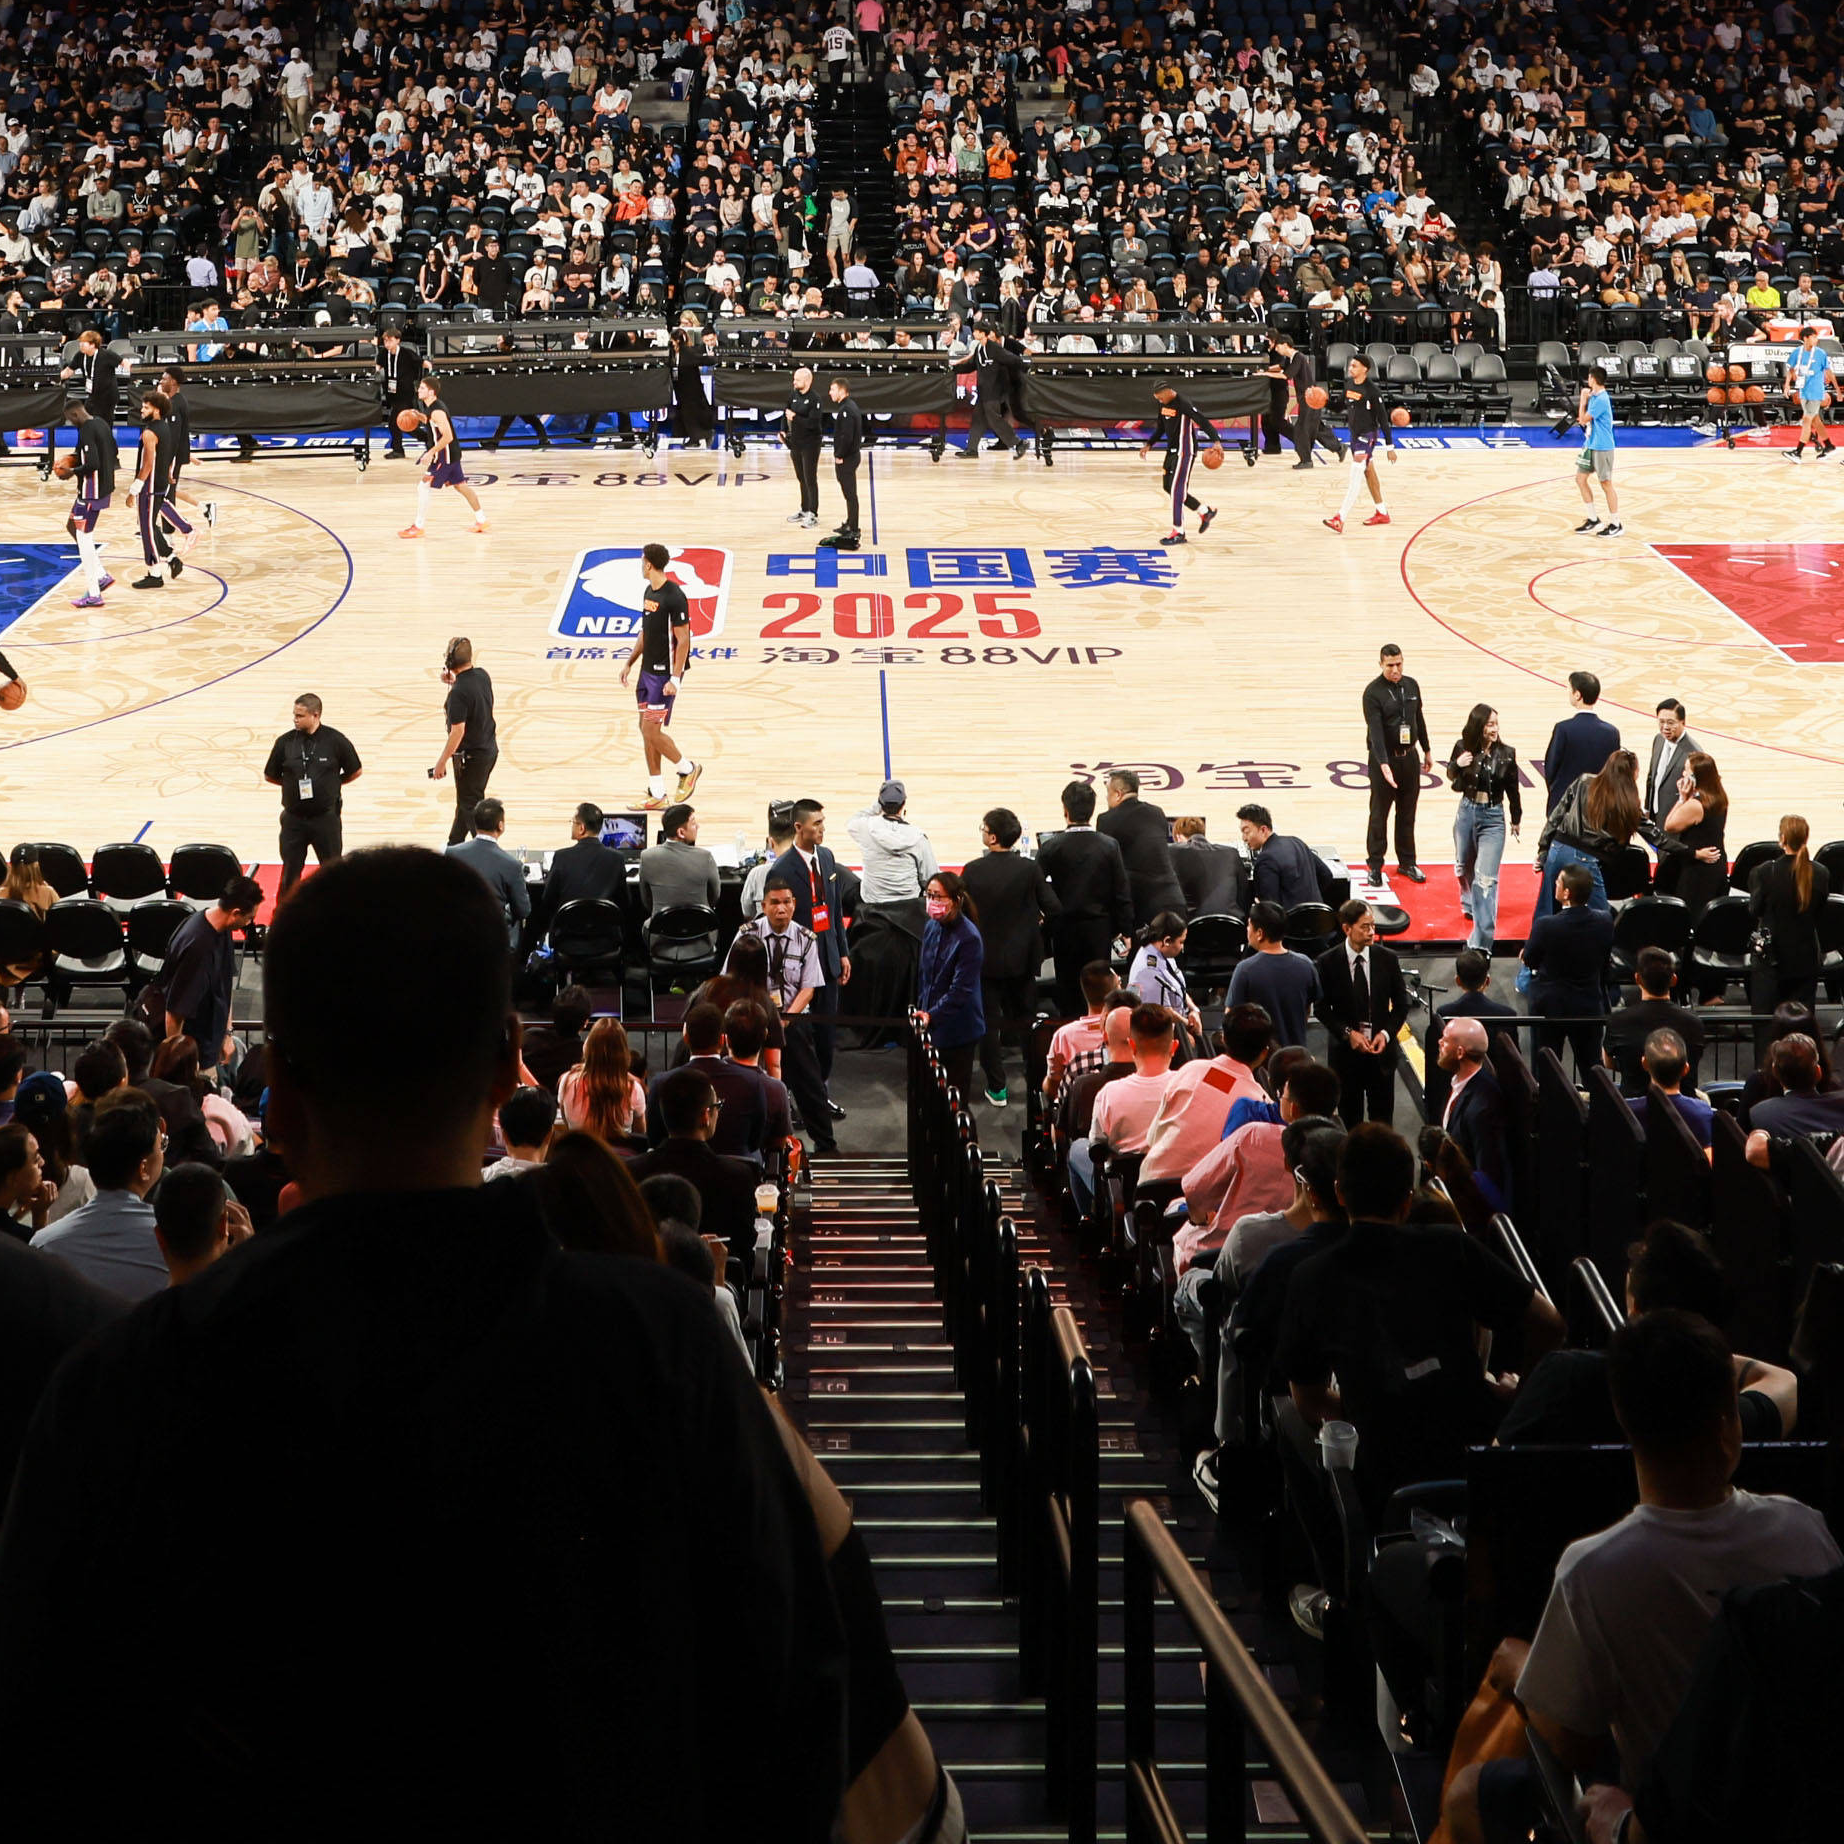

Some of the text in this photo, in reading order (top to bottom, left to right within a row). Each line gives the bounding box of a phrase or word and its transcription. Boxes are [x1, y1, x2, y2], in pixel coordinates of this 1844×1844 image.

[829, 37, 842, 49] 15
[767, 545, 1181, 589] 中国赛
[759, 592, 1042, 639] 2025
[761, 646, 1124, 665] 淘宝88VIP
